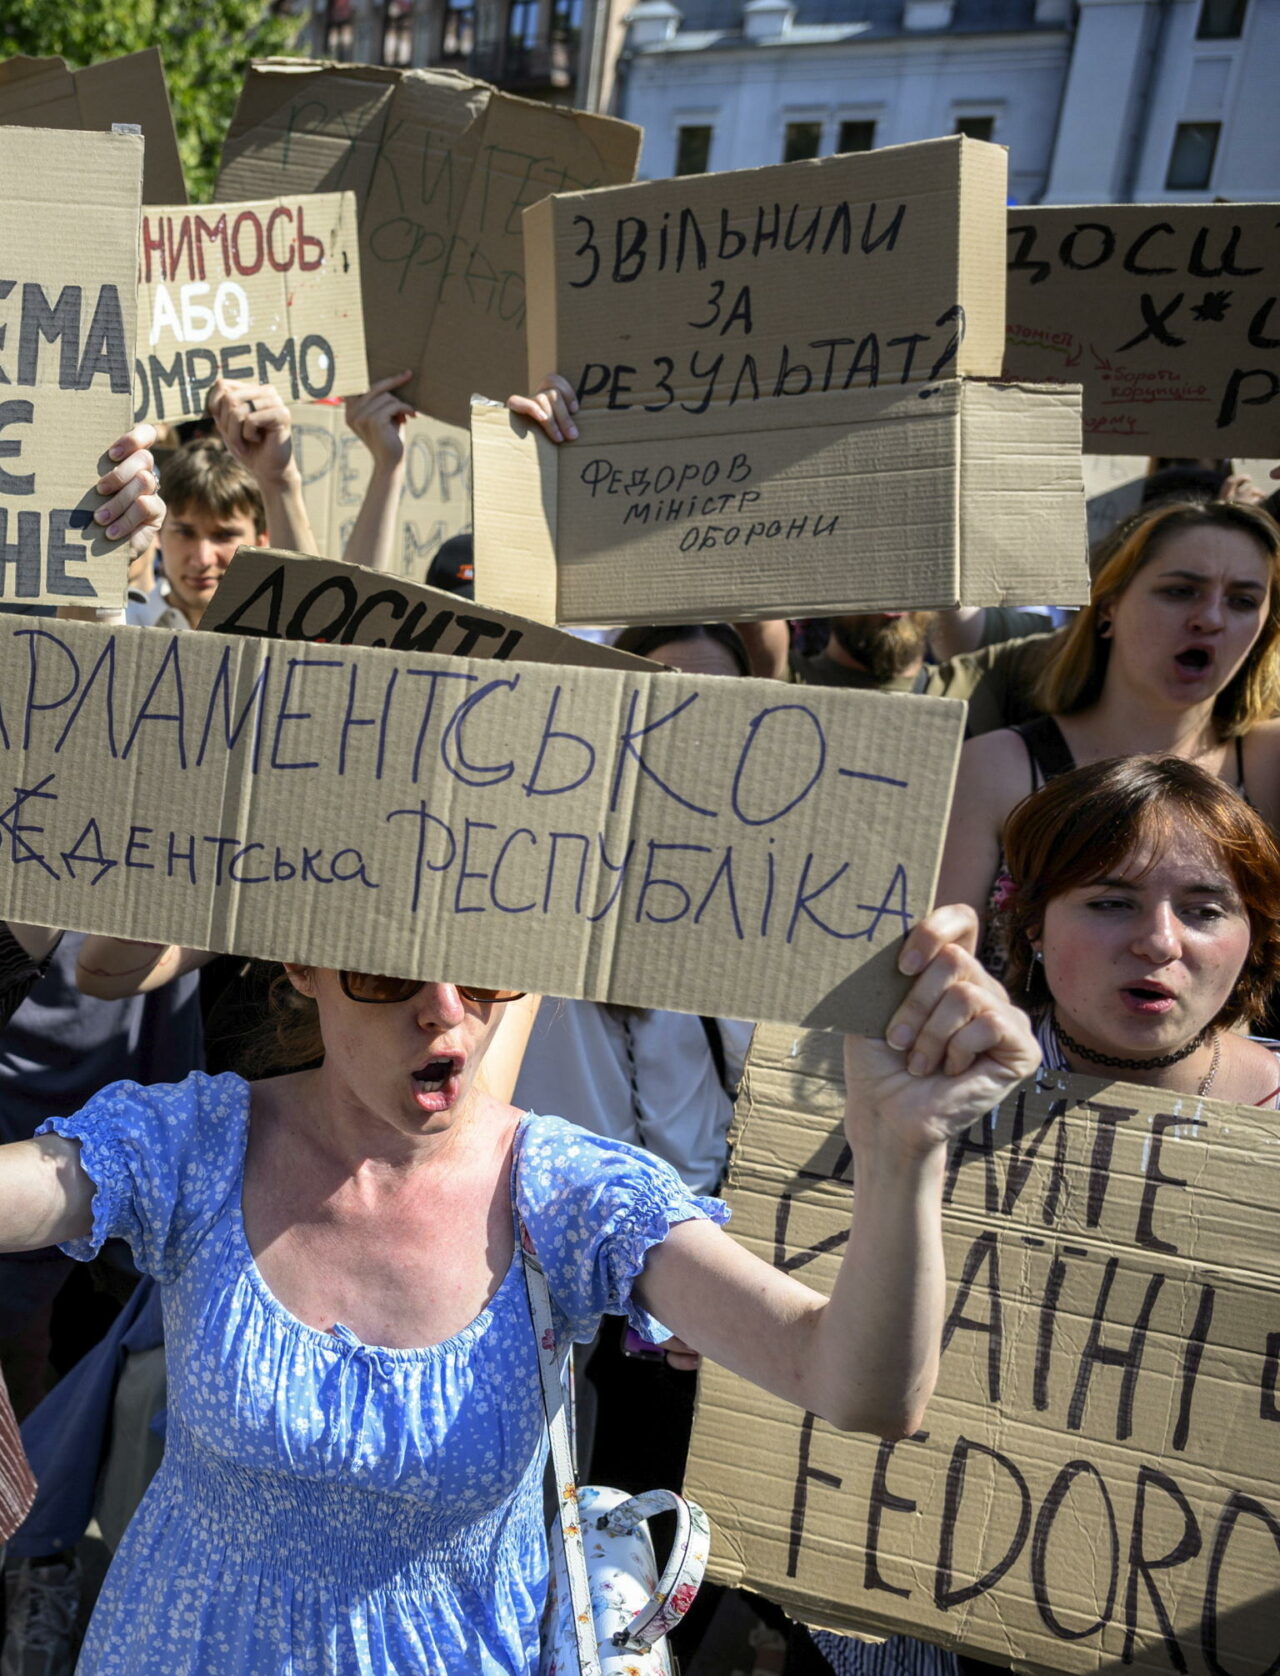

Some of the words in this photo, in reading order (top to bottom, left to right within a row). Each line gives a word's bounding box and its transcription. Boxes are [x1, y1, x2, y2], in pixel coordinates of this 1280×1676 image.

[138, 206, 325, 284] НИМОСЬ
[1007, 221, 1280, 285] ДОСИ
[149, 281, 250, 346] АБО
[688, 280, 753, 336] ЗА
[577, 304, 966, 414] РЕЗУЛЬТАТ?
[581, 453, 752, 498] ФЕДОРОВ
[387, 800, 915, 943] РЕСПУБЛІКА
[798, 1078, 1208, 1254] АЙТЕ
